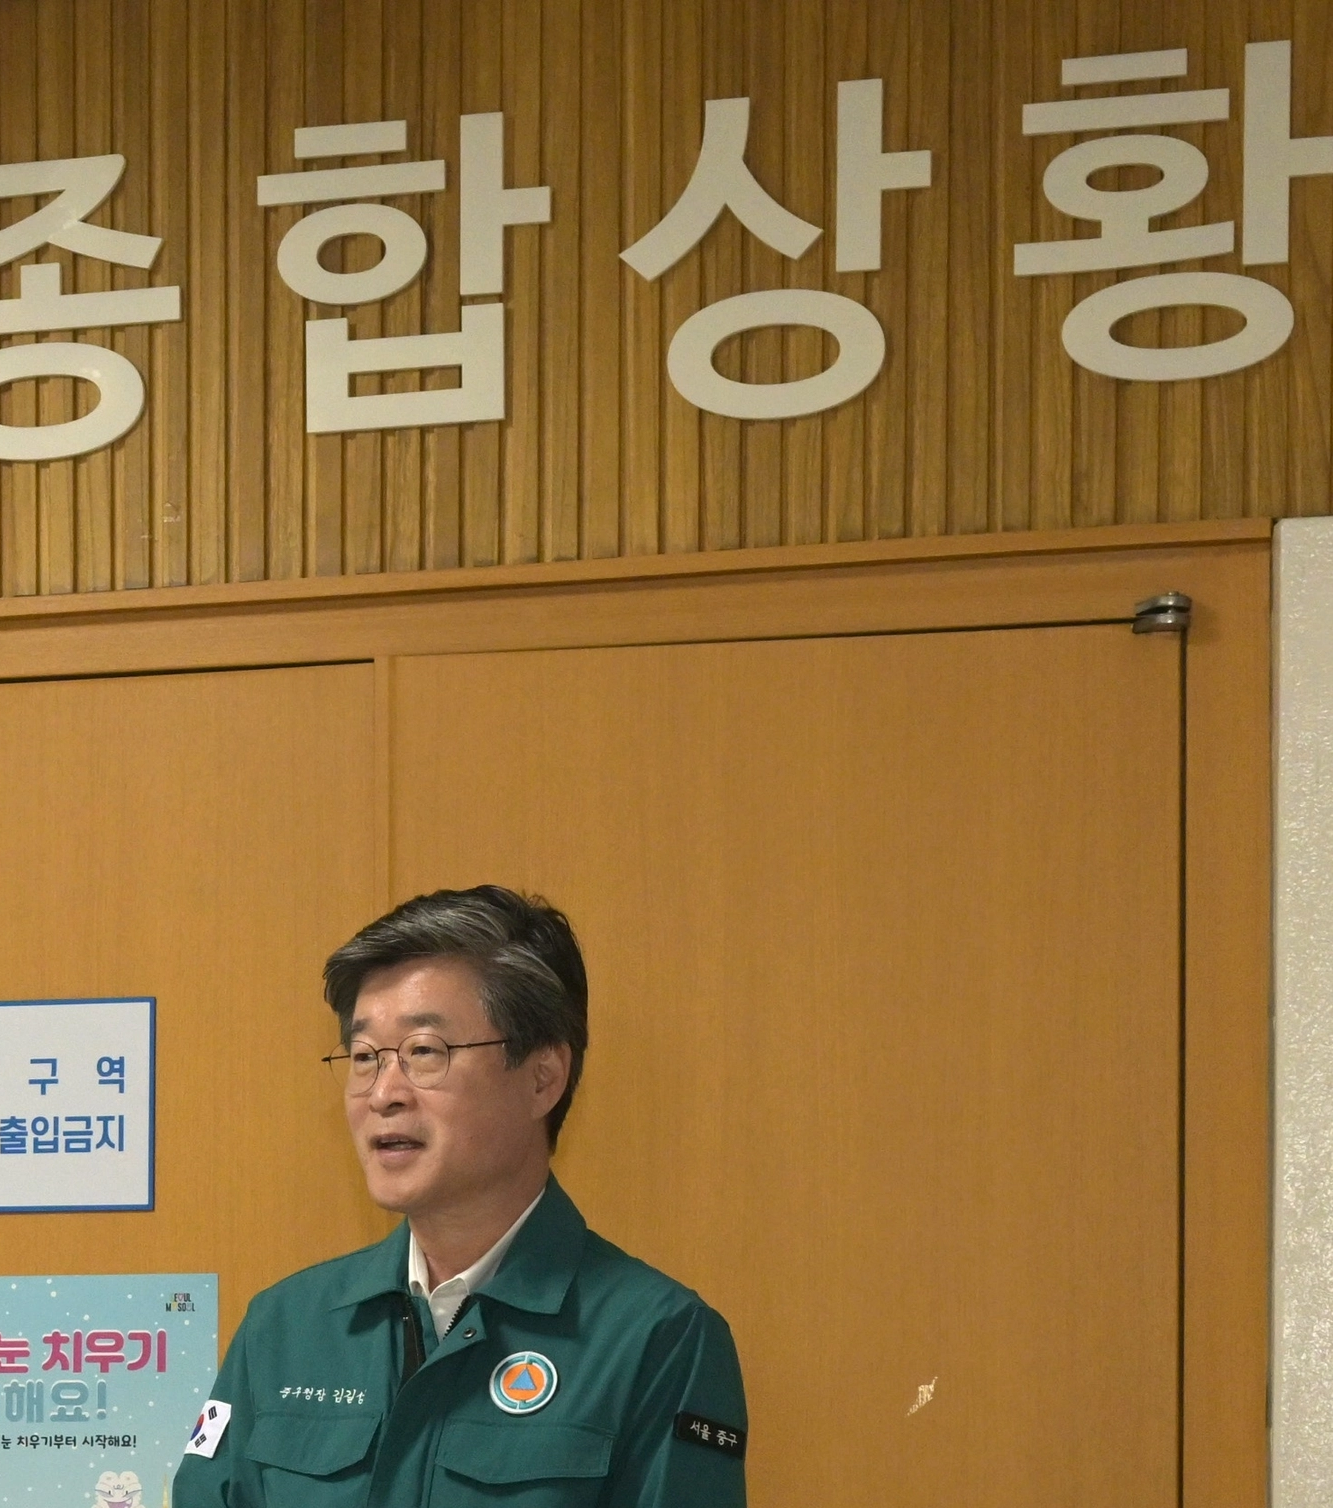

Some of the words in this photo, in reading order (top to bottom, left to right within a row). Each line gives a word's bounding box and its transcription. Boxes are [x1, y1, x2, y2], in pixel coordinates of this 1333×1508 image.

[42, 1328, 167, 1374] 치우기
[1, 1435, 12, 1449] 눈
[17, 1434, 77, 1449] 치우기부터
[82, 1434, 137, 1449] 시작해요!
[690, 1421, 711, 1441] 서울
[716, 1429, 738, 1447] 중구
